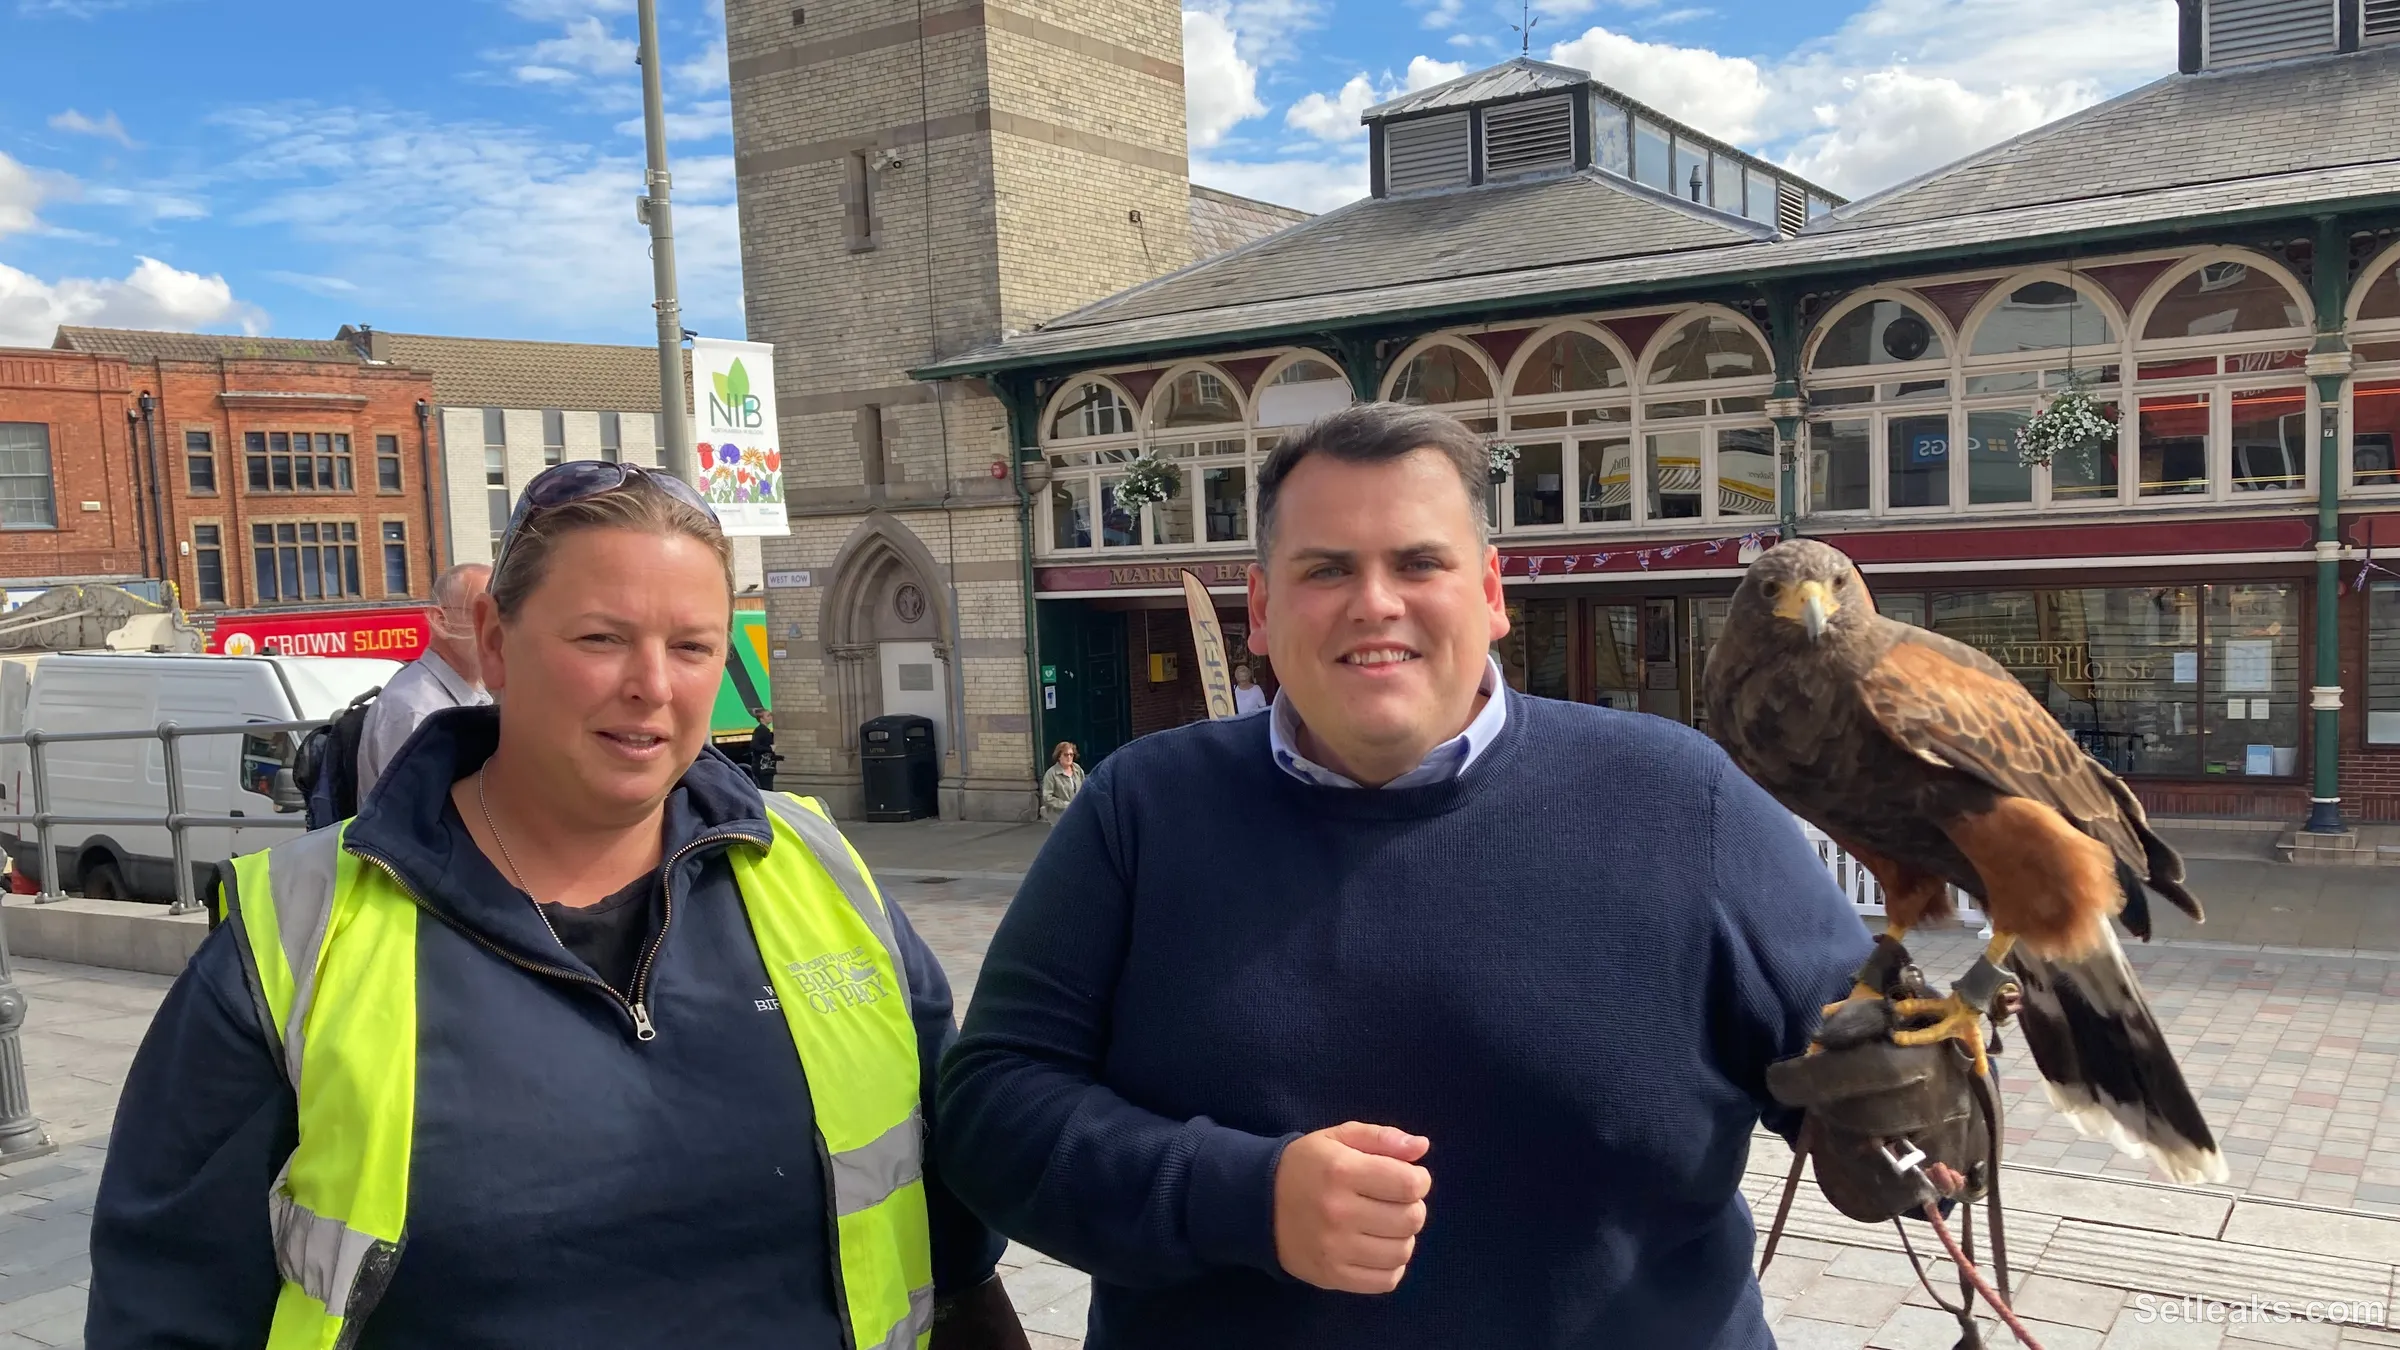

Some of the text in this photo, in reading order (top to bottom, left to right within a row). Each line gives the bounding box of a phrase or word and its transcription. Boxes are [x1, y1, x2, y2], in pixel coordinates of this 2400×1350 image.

[709, 391, 763, 428] NIB
[769, 574, 808, 584] WEST ROW
[264, 628, 418, 656] CROWN SLOTS
[1971, 634, 1998, 645] THE
